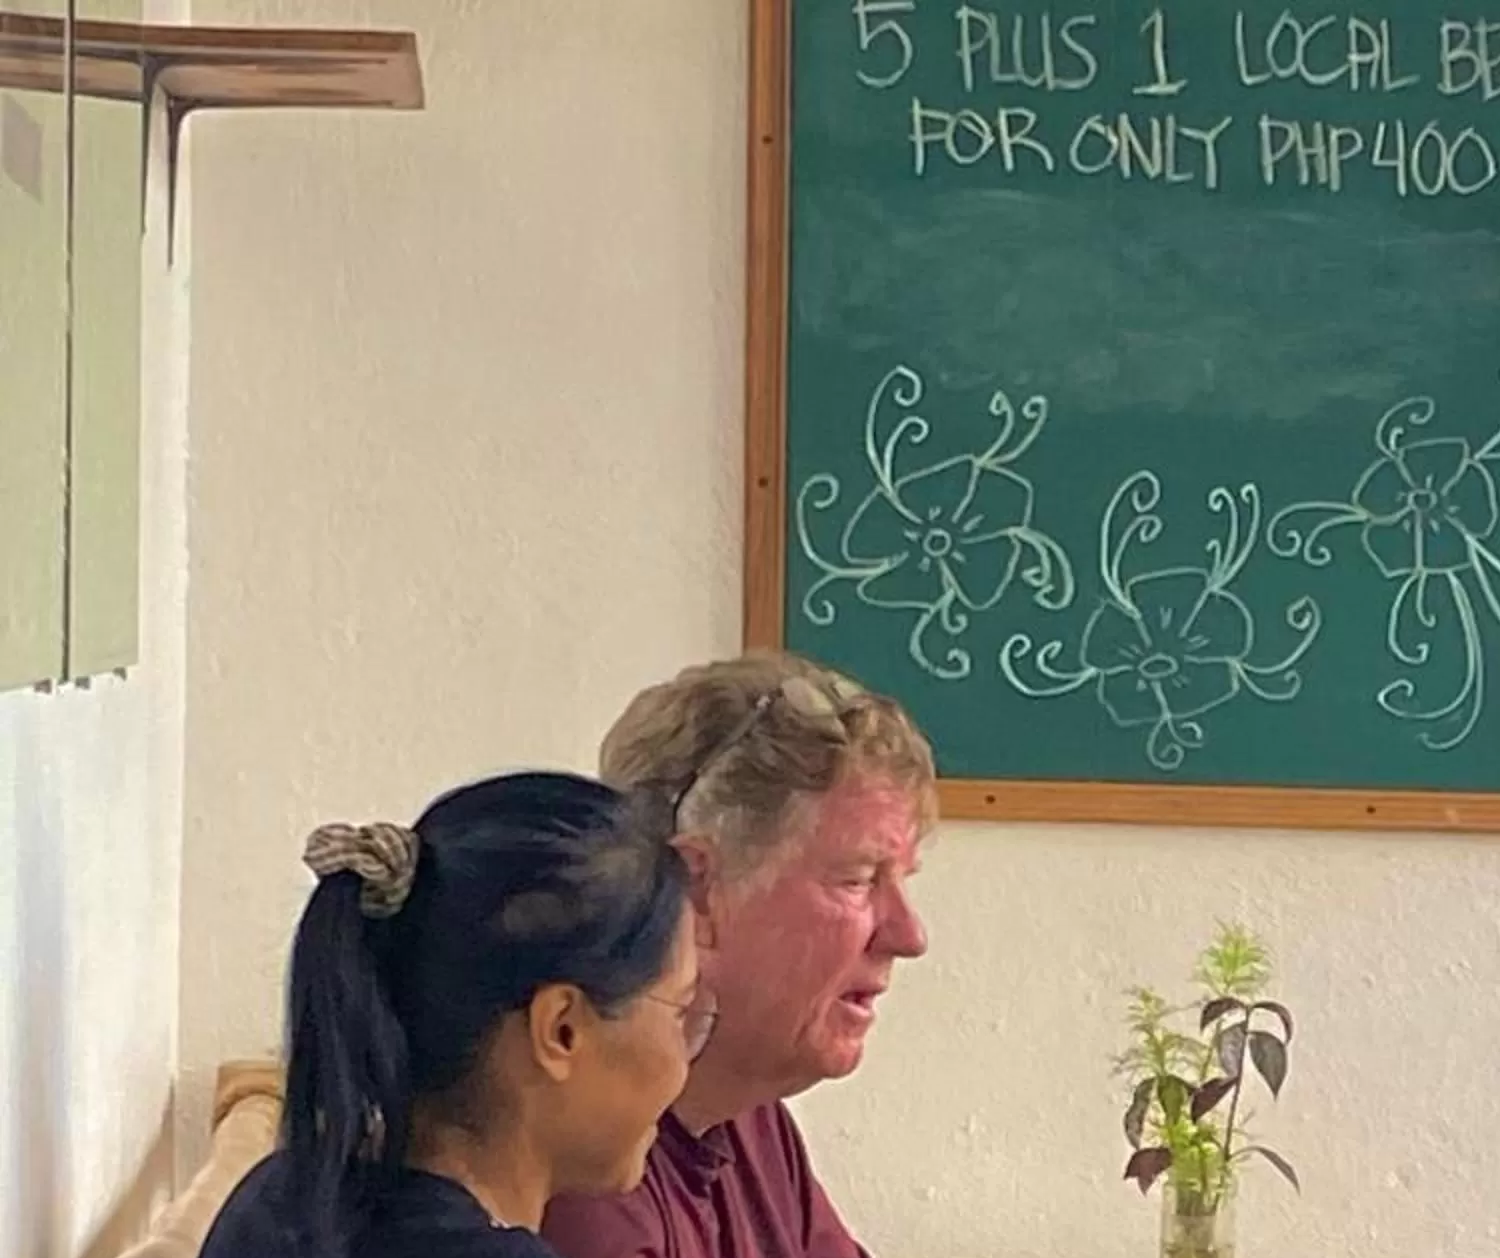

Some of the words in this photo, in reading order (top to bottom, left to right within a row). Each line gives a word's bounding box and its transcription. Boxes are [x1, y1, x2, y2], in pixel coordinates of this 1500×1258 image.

[852, 0, 915, 87] 5
[956, 5, 1097, 92] PLUS
[1133, 8, 1187, 95] 1
[1235, 10, 1420, 91] LOCAL
[908, 97, 1055, 176] FOR
[1068, 112, 1232, 189] ONLY
